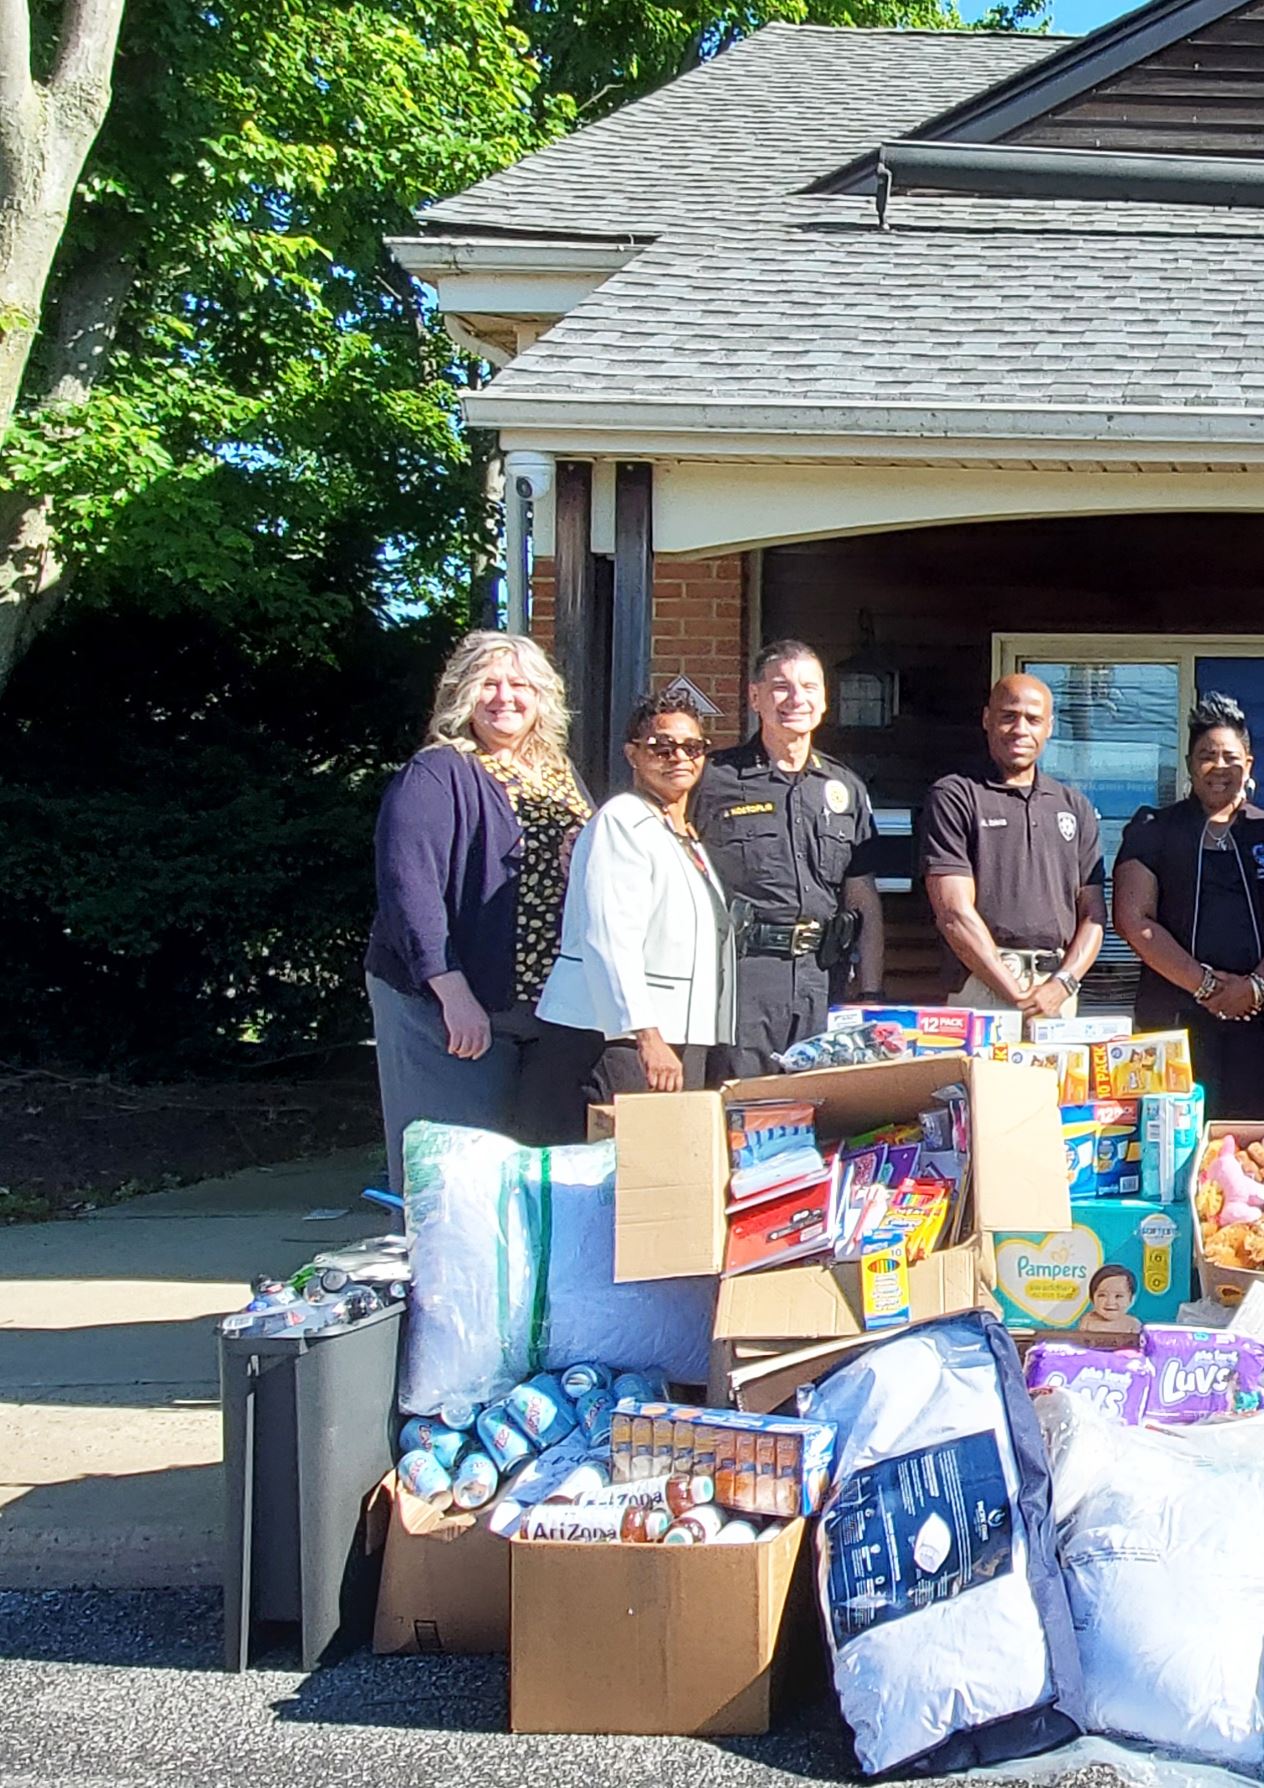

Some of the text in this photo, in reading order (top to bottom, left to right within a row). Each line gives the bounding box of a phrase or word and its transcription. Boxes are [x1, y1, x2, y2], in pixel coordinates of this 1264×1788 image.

[920, 1016, 964, 1033] 12 PACK
[1094, 1044, 1112, 1099] 10 PACK
[1016, 1255, 1088, 1280] Pampers
